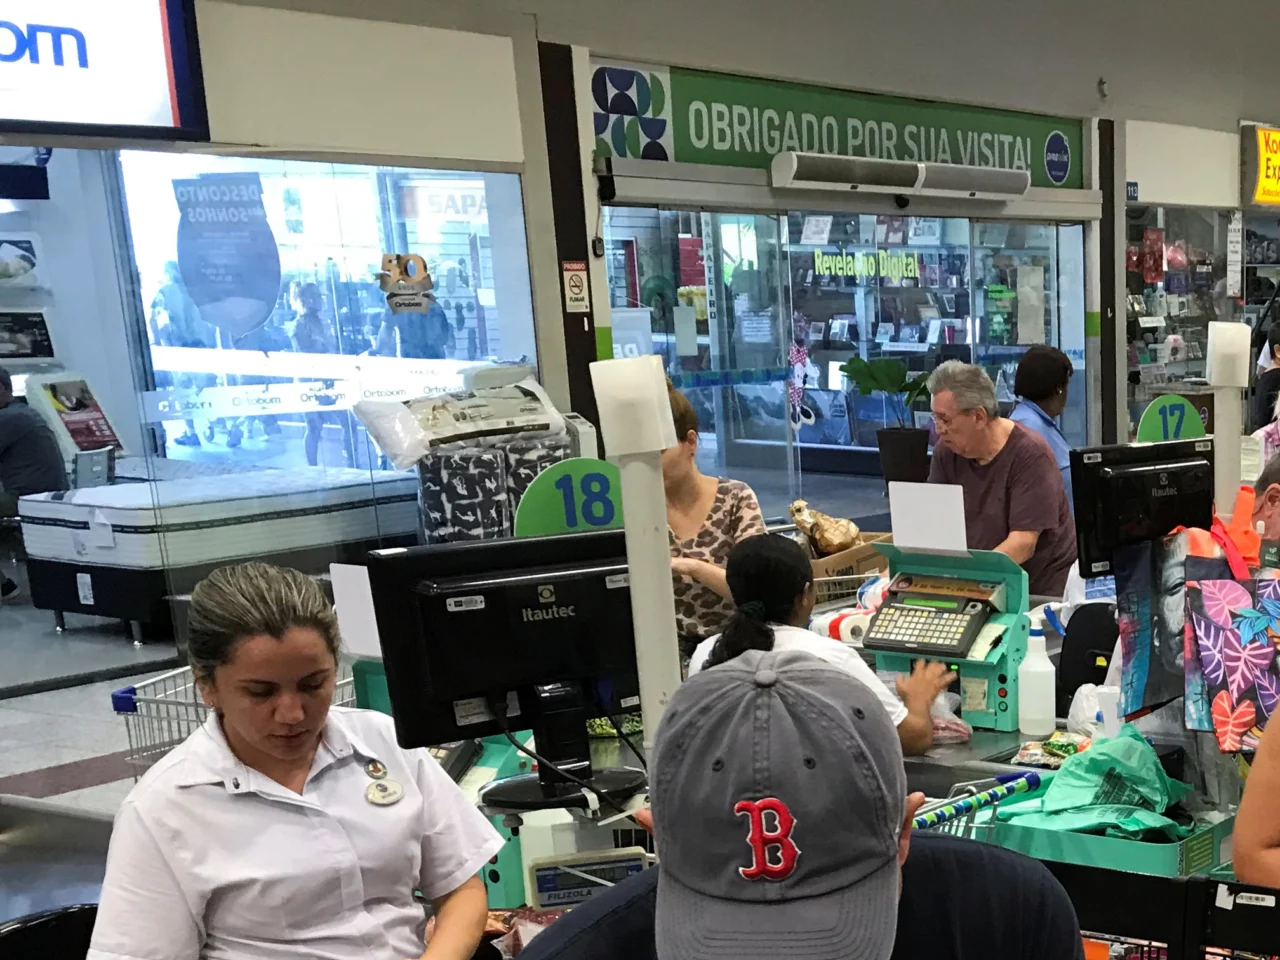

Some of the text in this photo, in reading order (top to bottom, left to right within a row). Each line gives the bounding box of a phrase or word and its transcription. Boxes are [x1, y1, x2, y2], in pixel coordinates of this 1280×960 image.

[688, 100, 839, 154] OBRIGADO
[847, 117, 898, 160] POR
[904, 124, 953, 164] SUA
[1127, 184, 1138, 197] 113
[378, 254, 428, 284] 50
[814, 248, 918, 283] Revelação Digital
[395, 300, 423, 309] Ortobom
[1158, 403, 1186, 440] 17
[555, 473, 615, 528] 18
[1151, 486, 1178, 497] Itautec
[522, 605, 576, 622] Itautec
[733, 797, 802, 881] B
[547, 888, 592, 900] FILIZOLA
